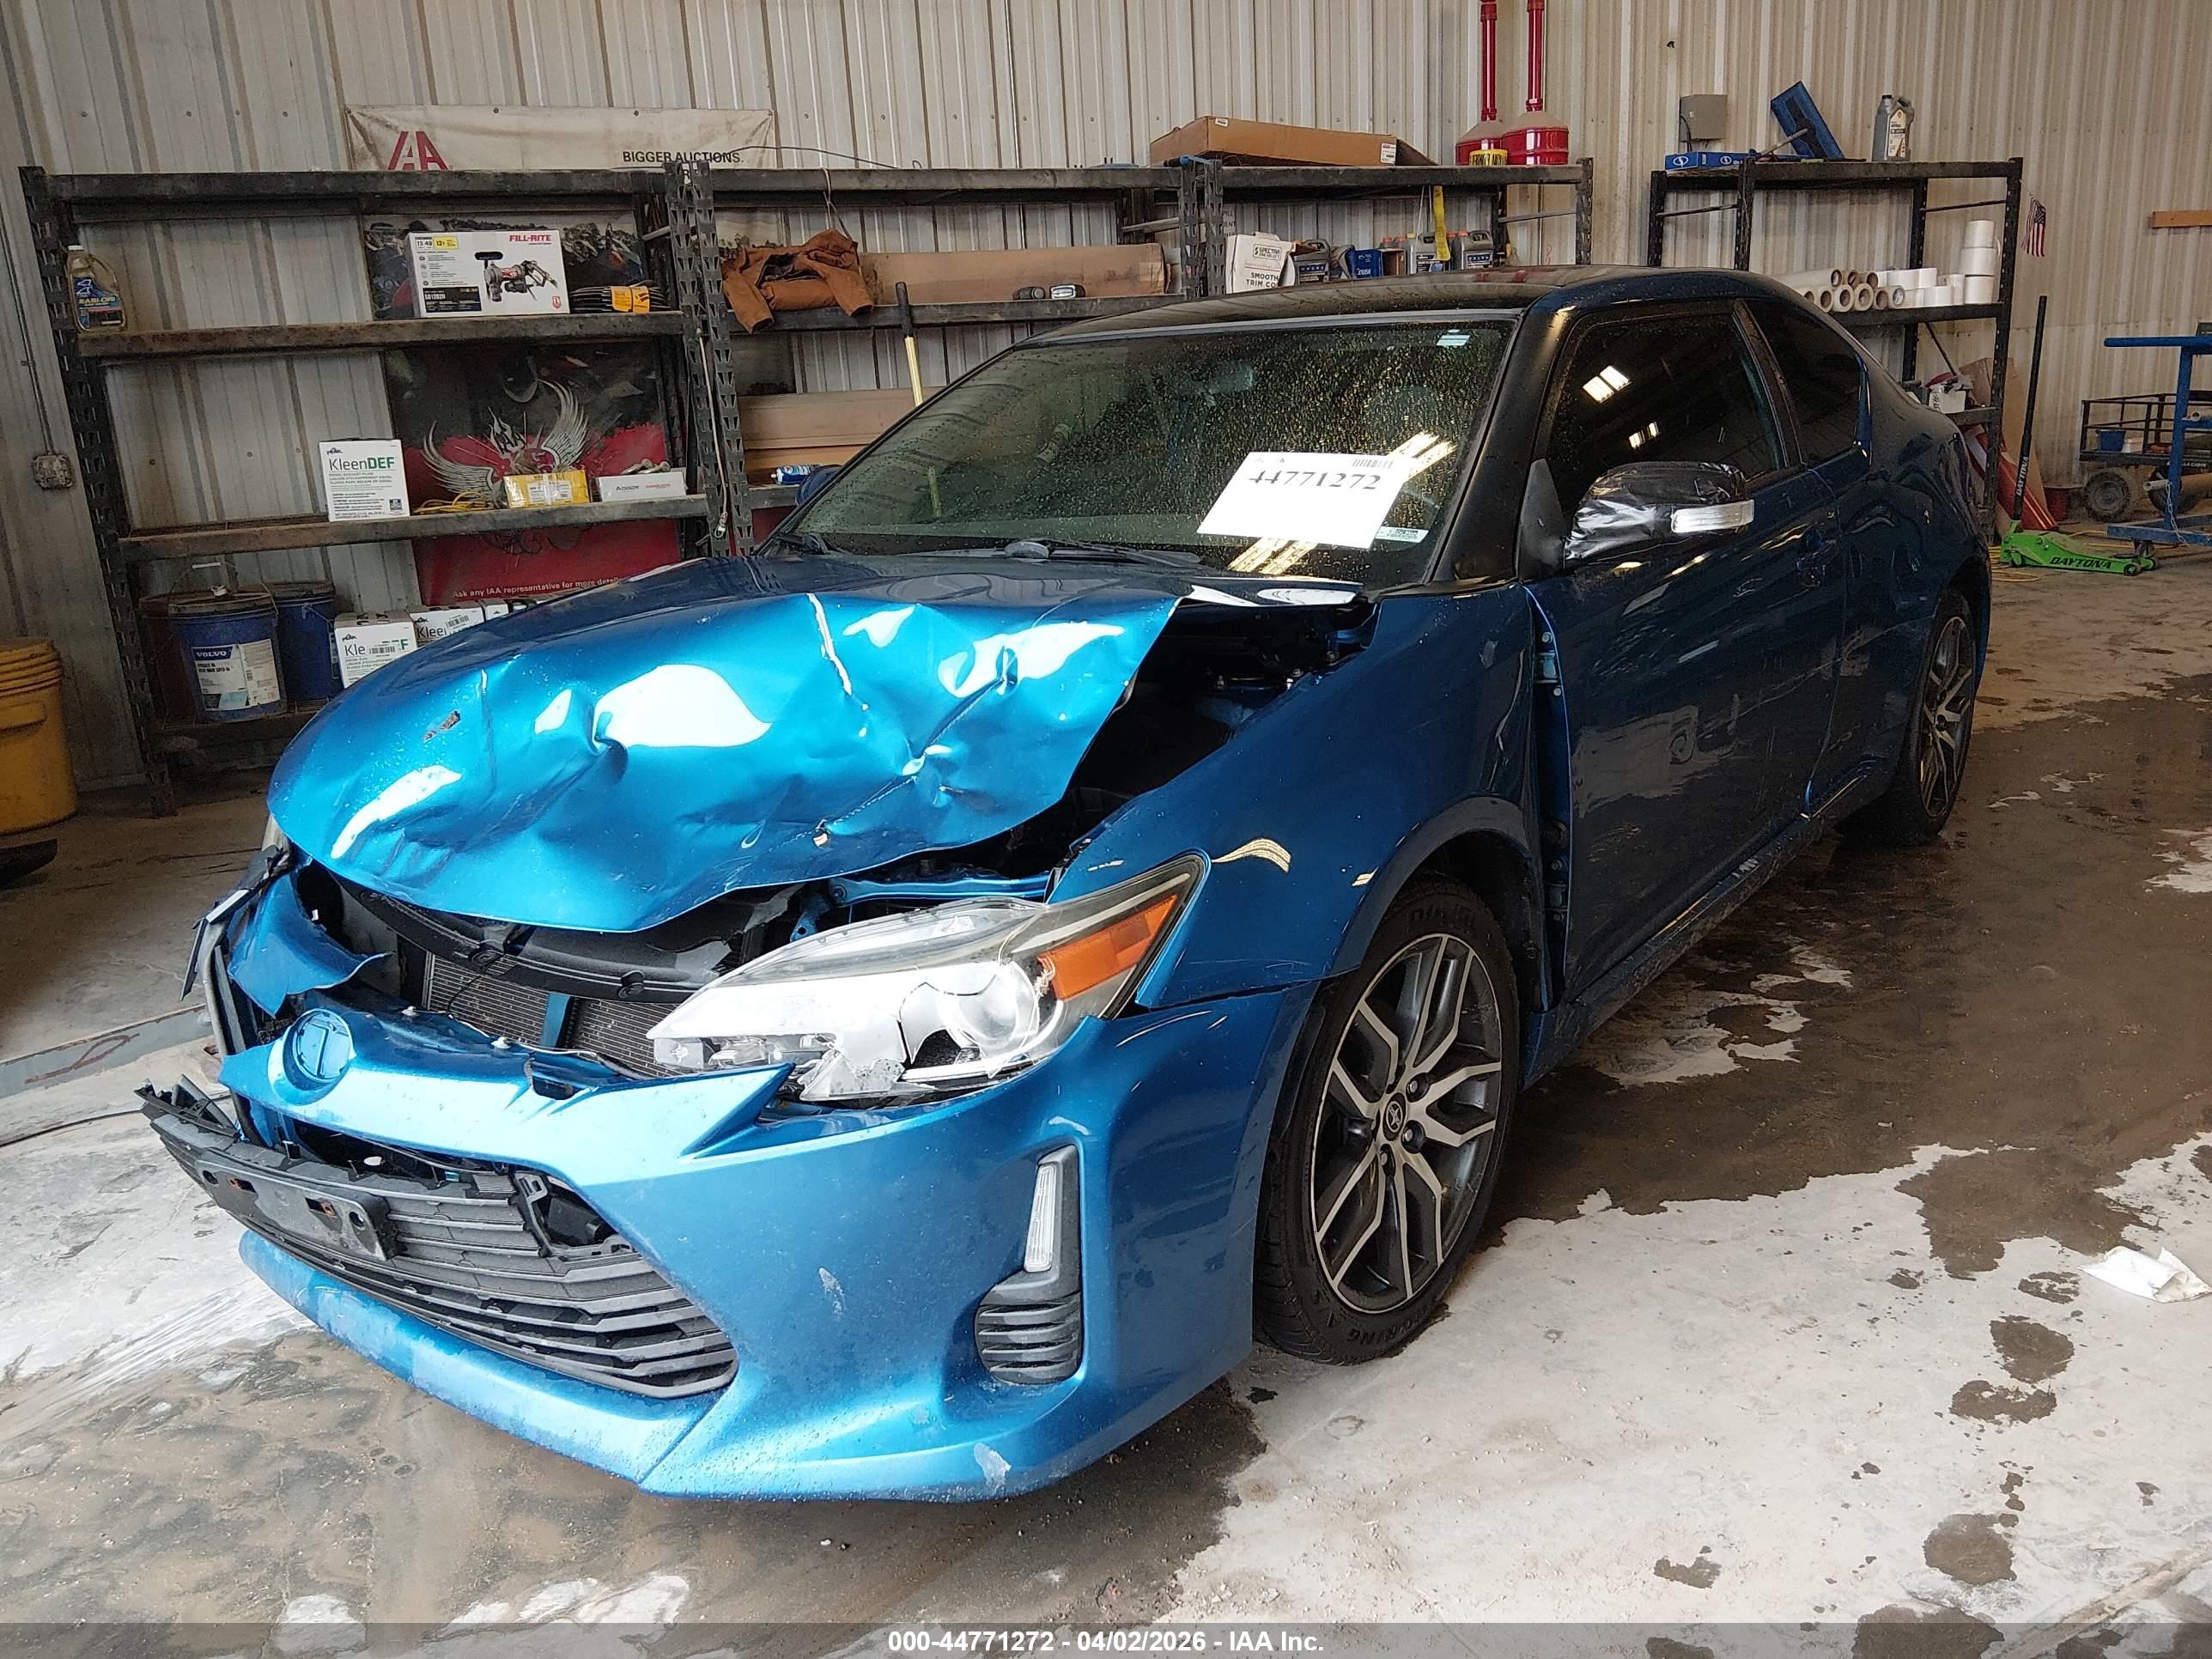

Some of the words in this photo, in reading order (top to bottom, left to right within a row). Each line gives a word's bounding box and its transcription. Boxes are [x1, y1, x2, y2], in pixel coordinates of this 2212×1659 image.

[623, 151, 671, 162] BIGGER
[329, 457, 395, 471] KleenDEF
[1249, 471, 1381, 489] 44771272
[2016, 456, 2029, 496] DAYTONA
[2050, 556, 2112, 568] DAYTONA
[504, 583, 560, 594] representative
